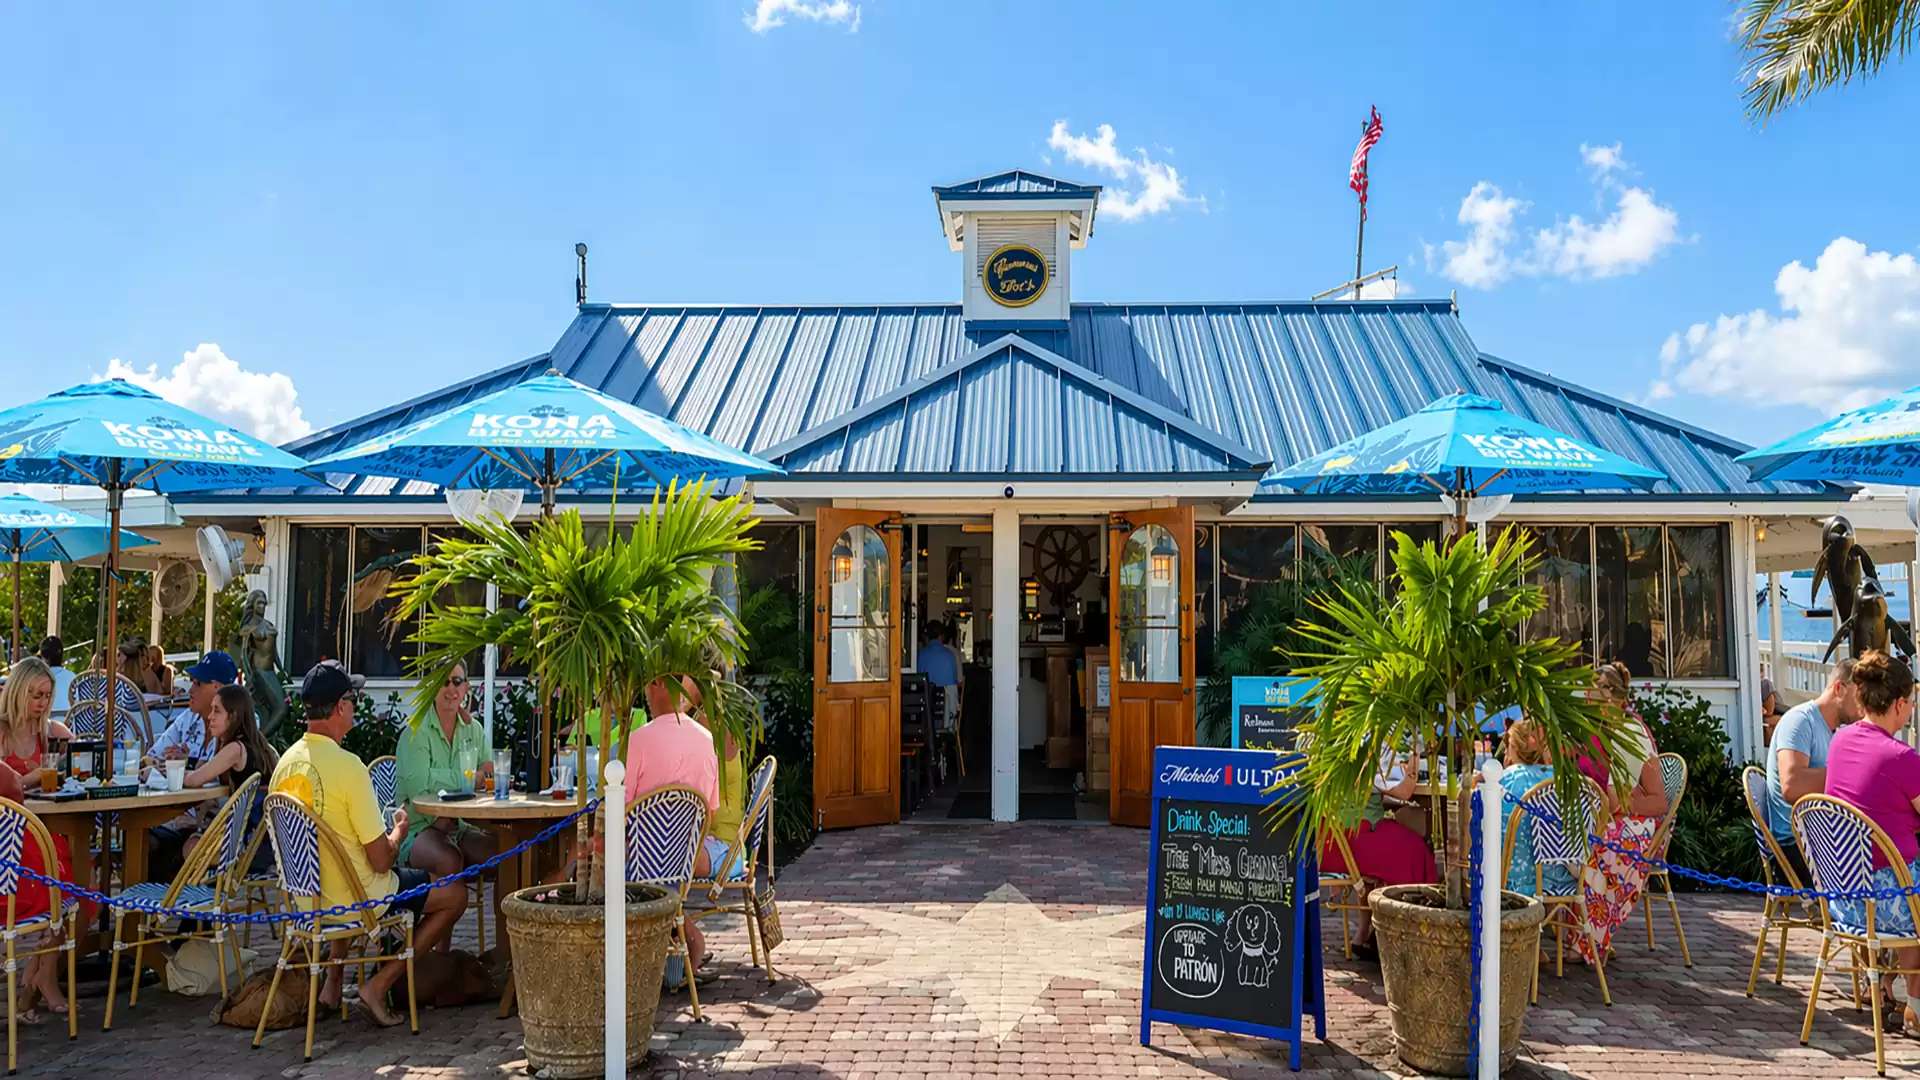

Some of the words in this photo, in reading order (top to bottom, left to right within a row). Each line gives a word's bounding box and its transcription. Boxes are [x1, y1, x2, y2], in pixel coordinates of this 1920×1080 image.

[471, 413, 617, 429] KONA
[101, 420, 248, 445] KONA
[468, 428, 523, 437] BIG
[530, 429, 617, 438] WAVE
[115, 436, 168, 449] BIG
[173, 441, 263, 456] WAVE
[1462, 433, 1594, 453] KONA
[1477, 447, 1525, 458] BIG
[1526, 450, 1604, 462] WAVE
[1160, 764, 1222, 784] Michelob
[1183, 943, 1195, 957] TO
